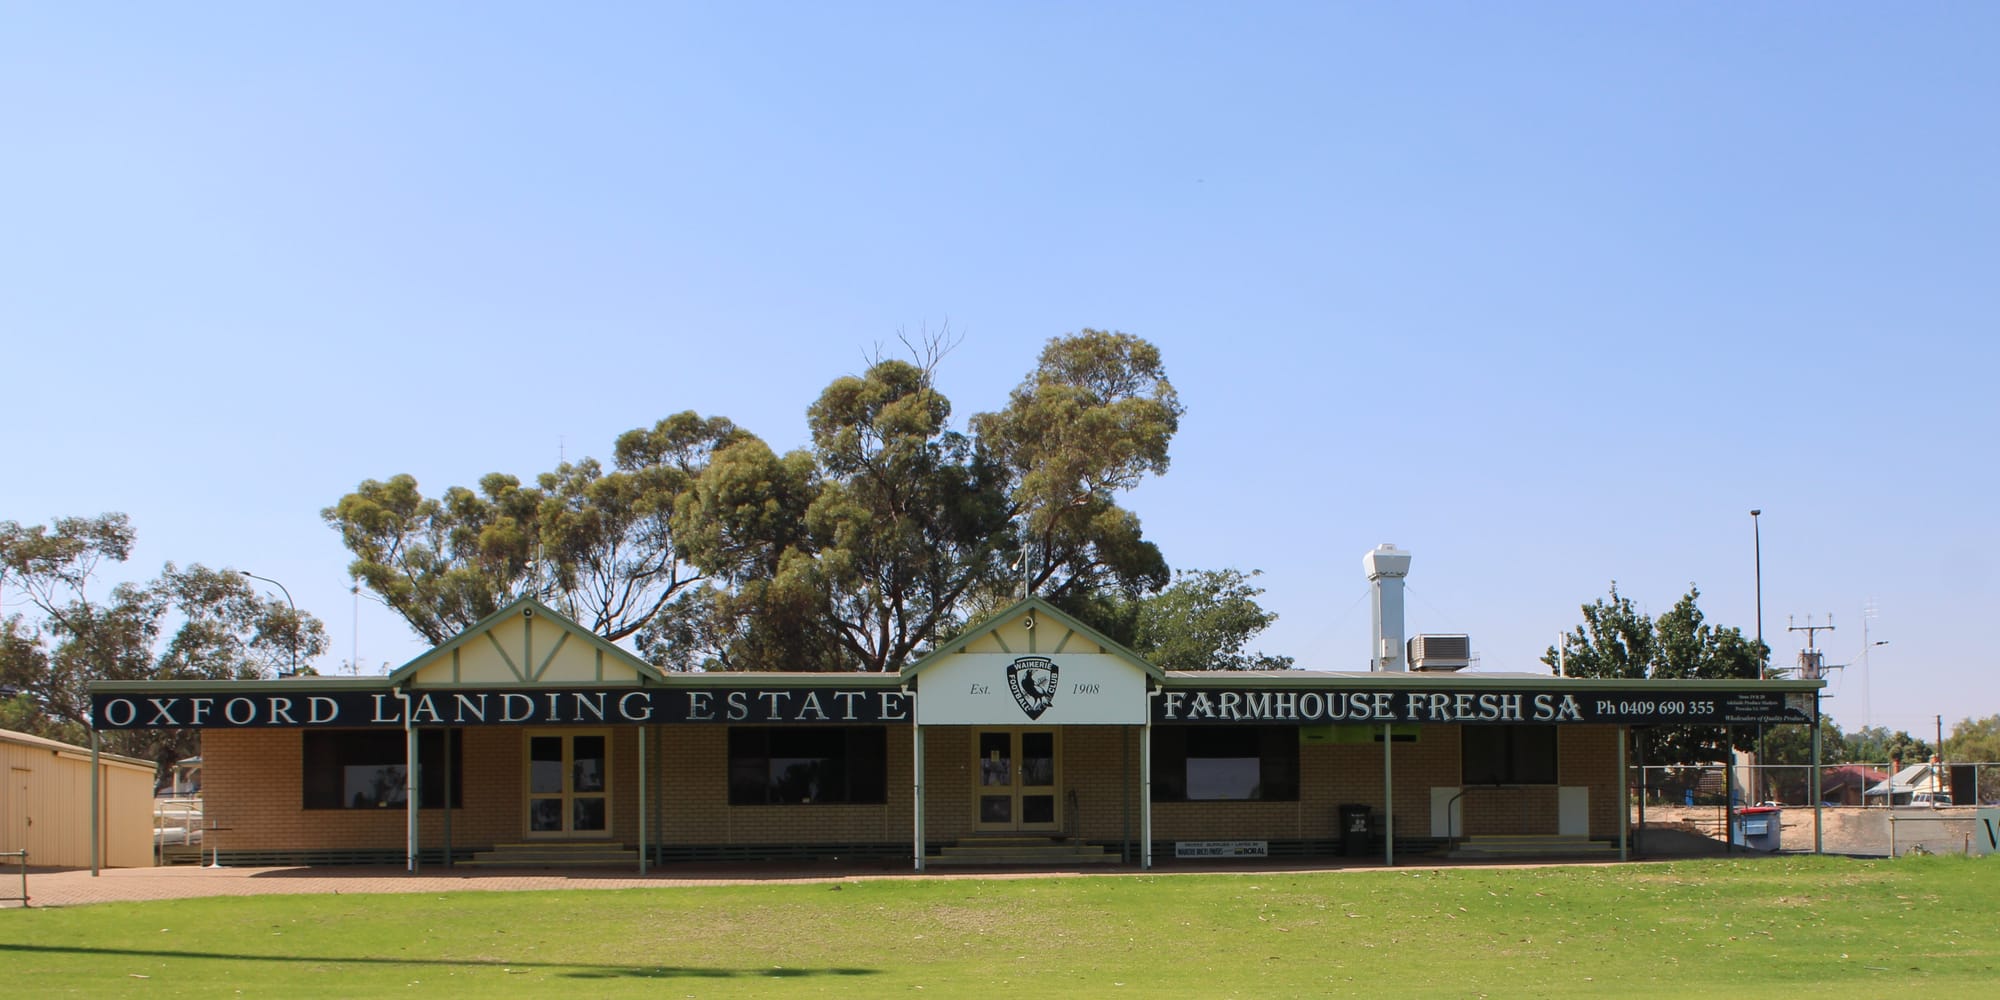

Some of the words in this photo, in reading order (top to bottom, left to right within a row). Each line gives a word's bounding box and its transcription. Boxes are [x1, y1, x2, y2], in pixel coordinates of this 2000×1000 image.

[969, 683, 991, 695] Est.
[1009, 674, 1032, 712] FOOTBALL
[1048, 673, 1058, 694] CLUB
[1072, 683, 1100, 695] 1908
[104, 697, 340, 727] OXFORD
[370, 691, 655, 723] LANDING
[685, 690, 908, 721] ESTATE
[1162, 691, 1398, 721] FARMHOUSE
[1405, 693, 1525, 721] FRESH
[1533, 694, 1585, 722] SA
[1596, 700, 1616, 715] Ph
[1619, 701, 1655, 715] 0409
[1658, 701, 1685, 715] 690
[1688, 701, 1715, 715] 355
